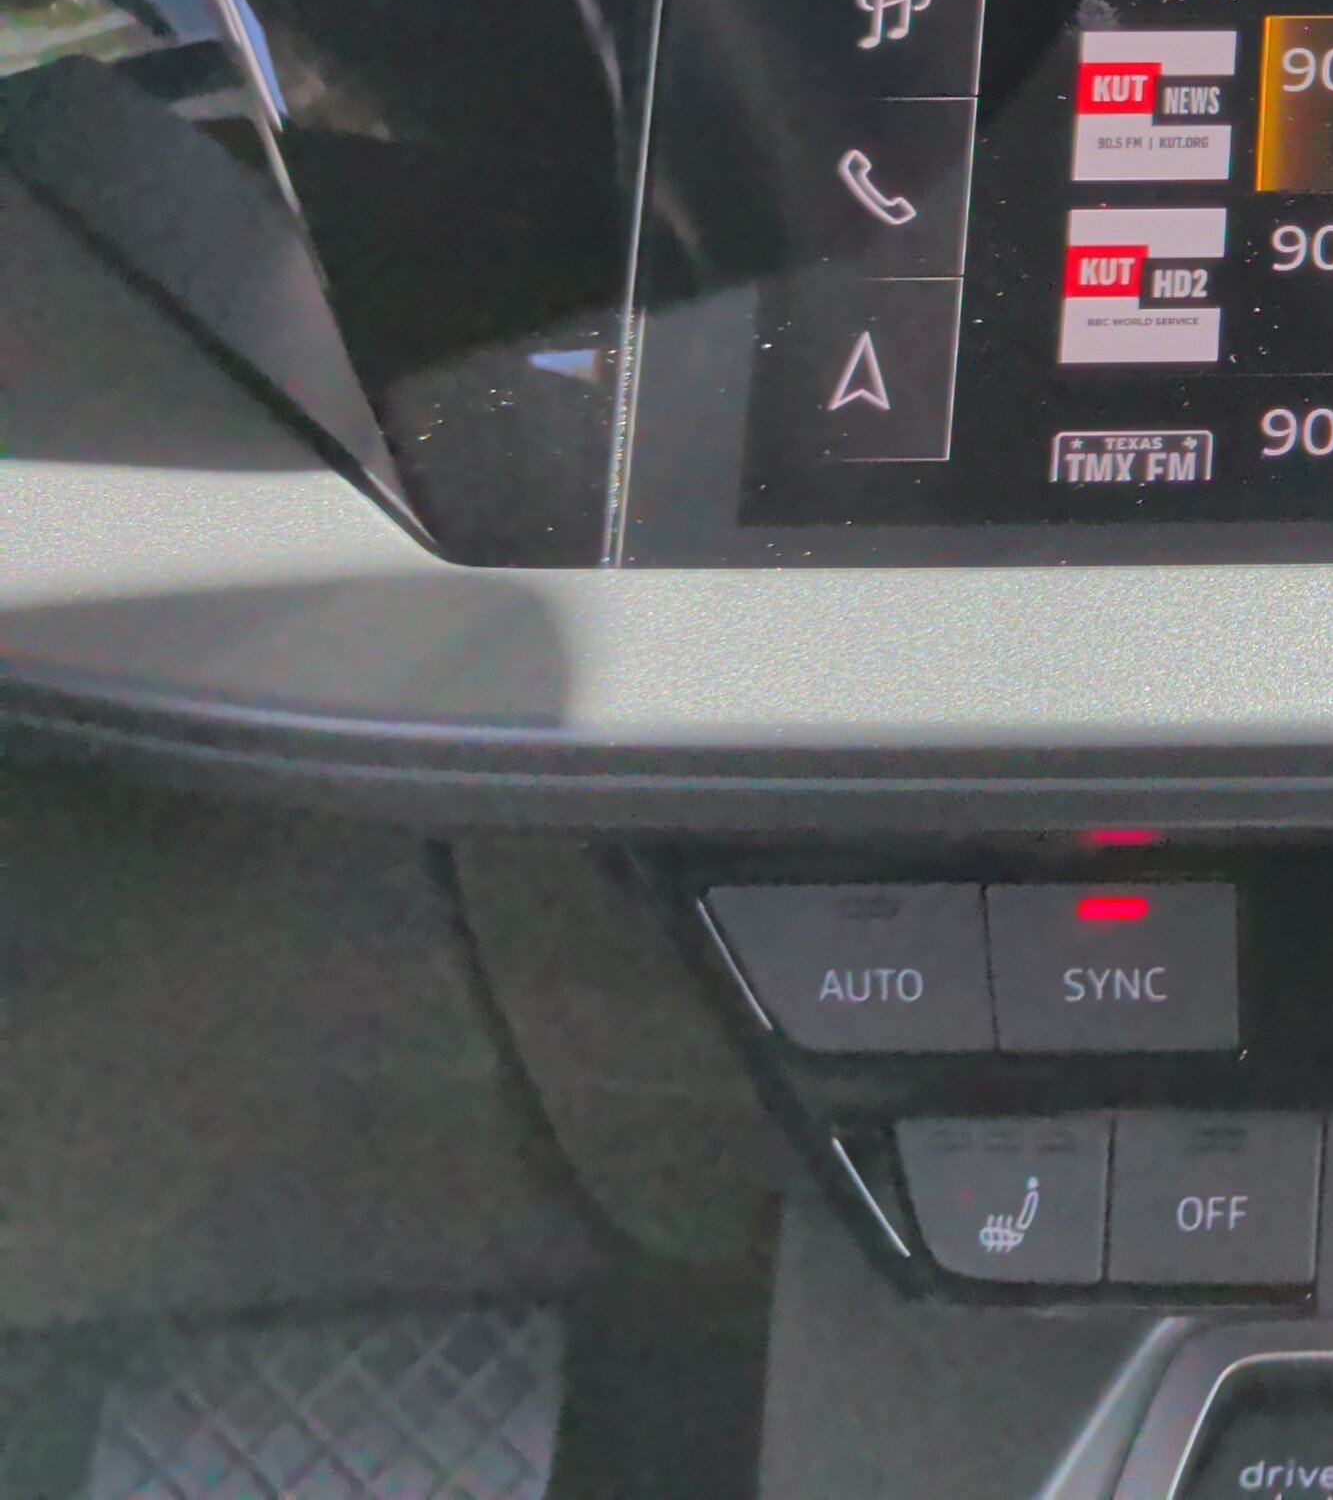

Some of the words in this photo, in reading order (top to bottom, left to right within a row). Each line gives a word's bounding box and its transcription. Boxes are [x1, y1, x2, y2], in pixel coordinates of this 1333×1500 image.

[1092, 74, 1149, 103] KUT
[1162, 85, 1221, 116] NEWS
[1126, 136, 1143, 149] FM
[1079, 257, 1136, 286] KUT
[1151, 268, 1209, 299] HD2
[1112, 317, 1153, 327] WORLD
[1155, 317, 1199, 326] SERVICE
[1104, 436, 1164, 450] TEXAS
[1065, 452, 1136, 482] TMX
[1146, 451, 1198, 482] FM
[818, 969, 924, 1002] AUTO
[1063, 967, 1168, 1002] SYNC
[1175, 1196, 1249, 1232] OFF
